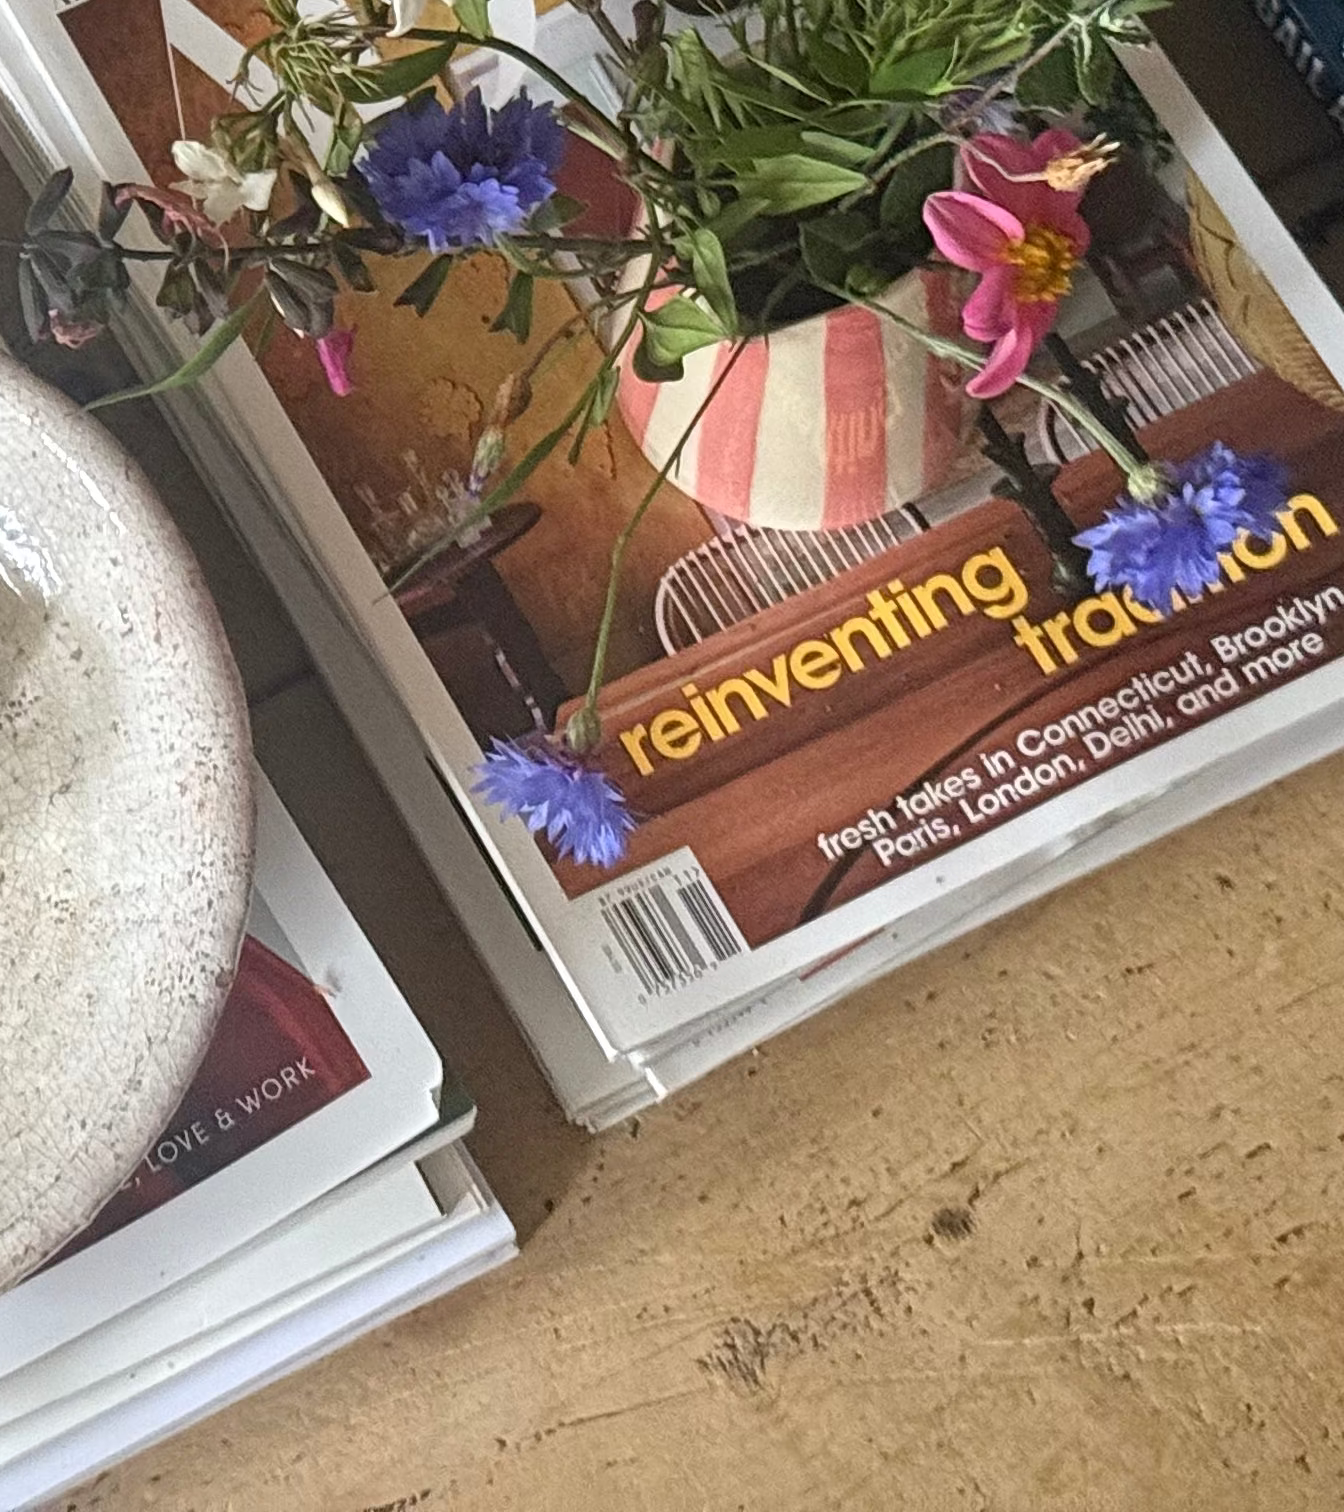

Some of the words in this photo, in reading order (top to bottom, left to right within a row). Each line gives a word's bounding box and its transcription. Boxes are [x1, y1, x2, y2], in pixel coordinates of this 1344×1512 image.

[619, 546, 1029, 777] reinventing
[816, 807, 898, 862] fresh
[894, 766, 983, 821] takes
[980, 749, 1016, 779] in
[1016, 650, 1213, 757] Connecticut,
[872, 816, 962, 868] Paris,
[958, 750, 1087, 824] London,
[1082, 704, 1175, 761] Delhi,
[1177, 668, 1241, 716] and
[1241, 631, 1326, 686] more
[143, 1121, 210, 1174] LOVE
[214, 1107, 235, 1131] &
[235, 1056, 316, 1115] WORK
